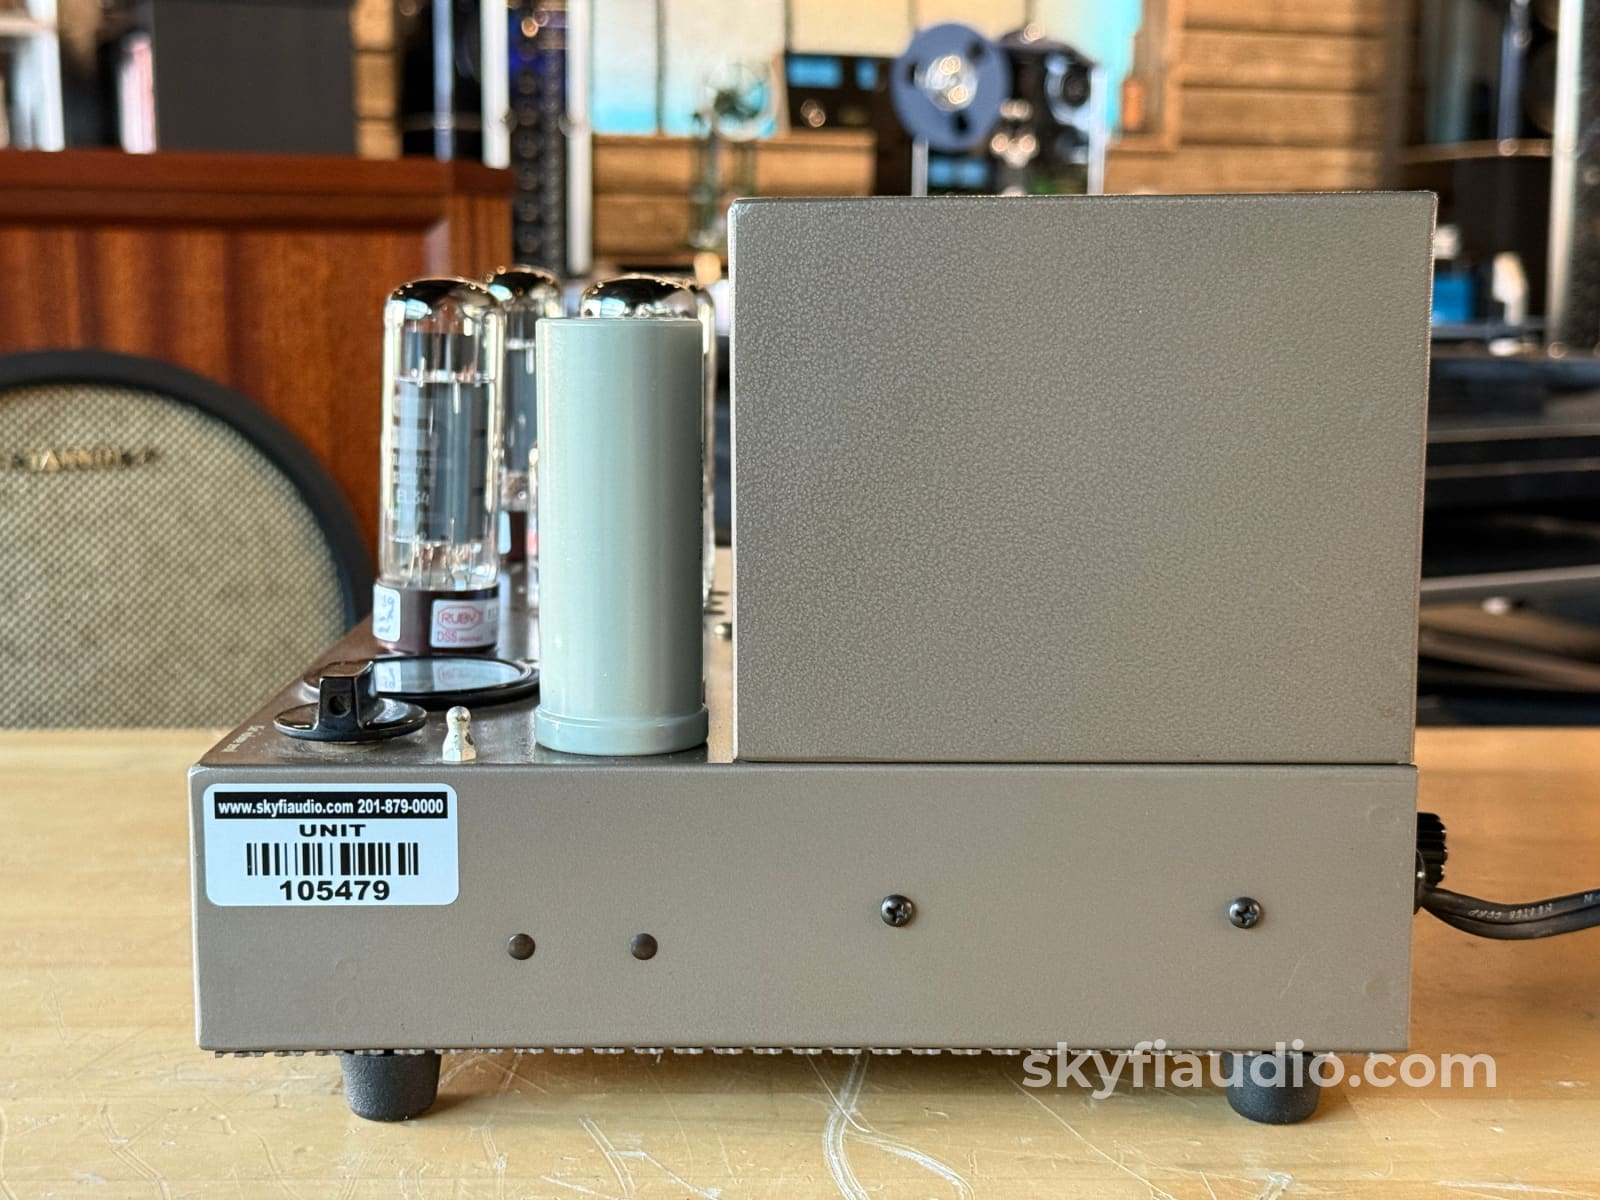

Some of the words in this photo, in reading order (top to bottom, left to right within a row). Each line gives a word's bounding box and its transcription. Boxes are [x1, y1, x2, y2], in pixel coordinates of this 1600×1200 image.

[441, 612, 475, 624] RUBY
[218, 799, 354, 818] www.skyfiaudio.com
[357, 798, 444, 814] 201-879-0000
[299, 824, 366, 837] UNIT
[279, 880, 390, 901] 105479
